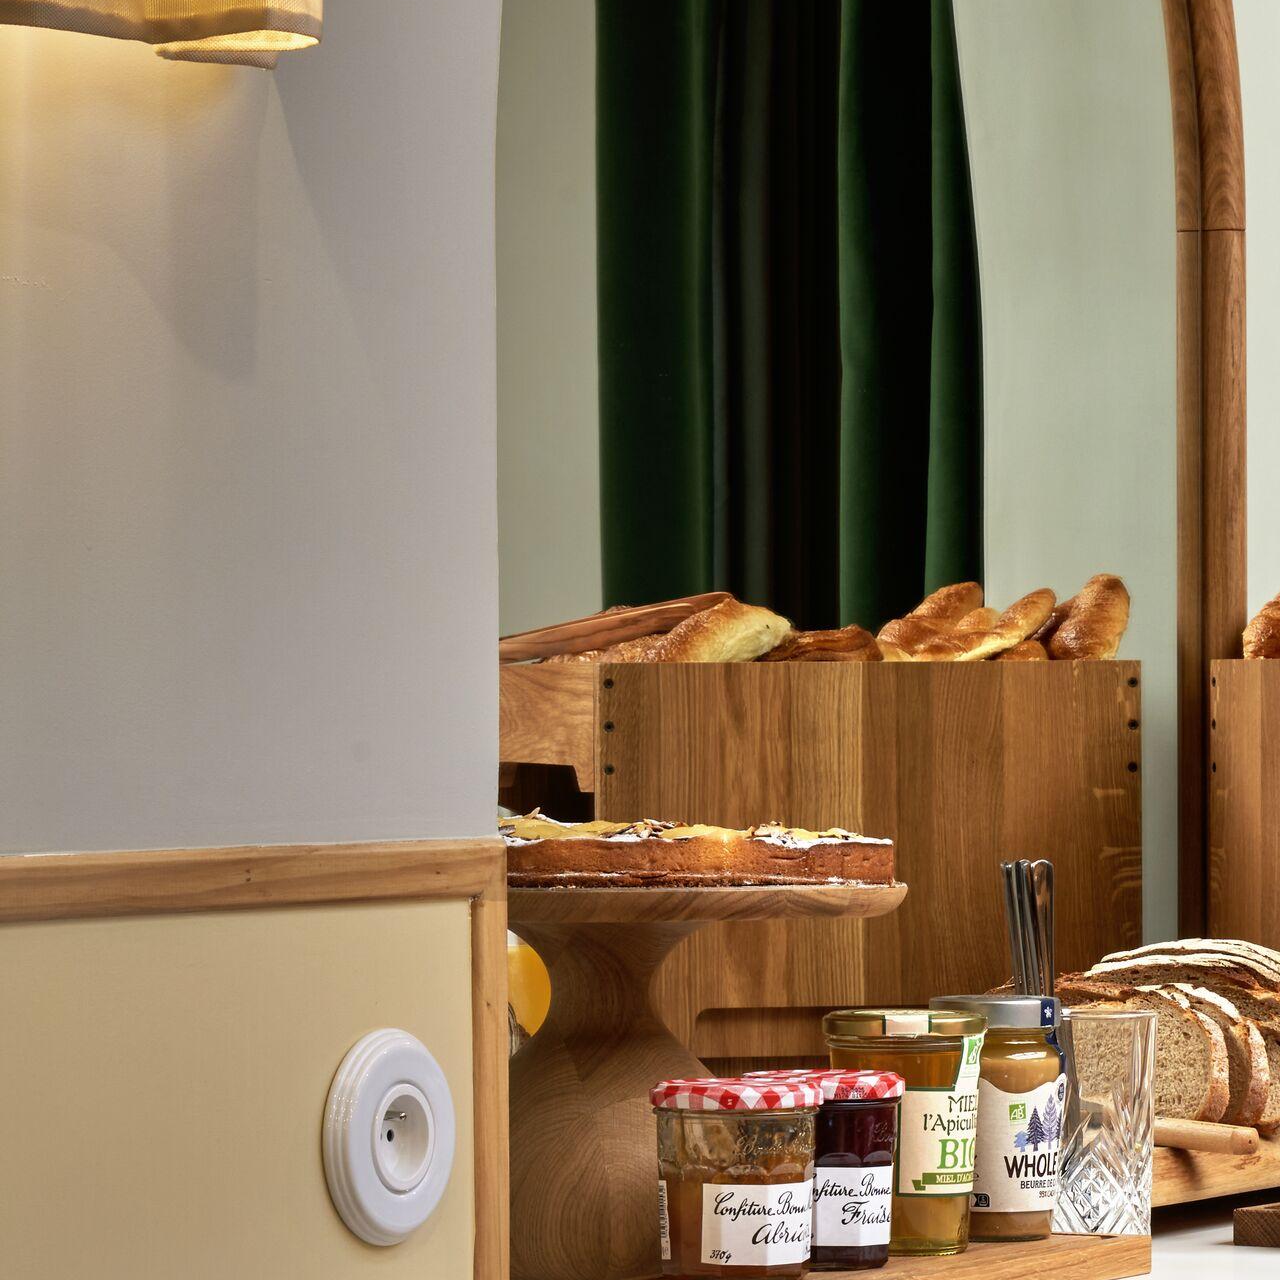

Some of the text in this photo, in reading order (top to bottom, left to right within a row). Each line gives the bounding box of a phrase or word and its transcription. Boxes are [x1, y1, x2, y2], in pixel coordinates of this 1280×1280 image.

[935, 1174, 956, 1184] MIEL
[1020, 1179, 1047, 1190] BEURRE
[713, 1191, 776, 1222] Confiture
[709, 1249, 732, 1264] 370g
